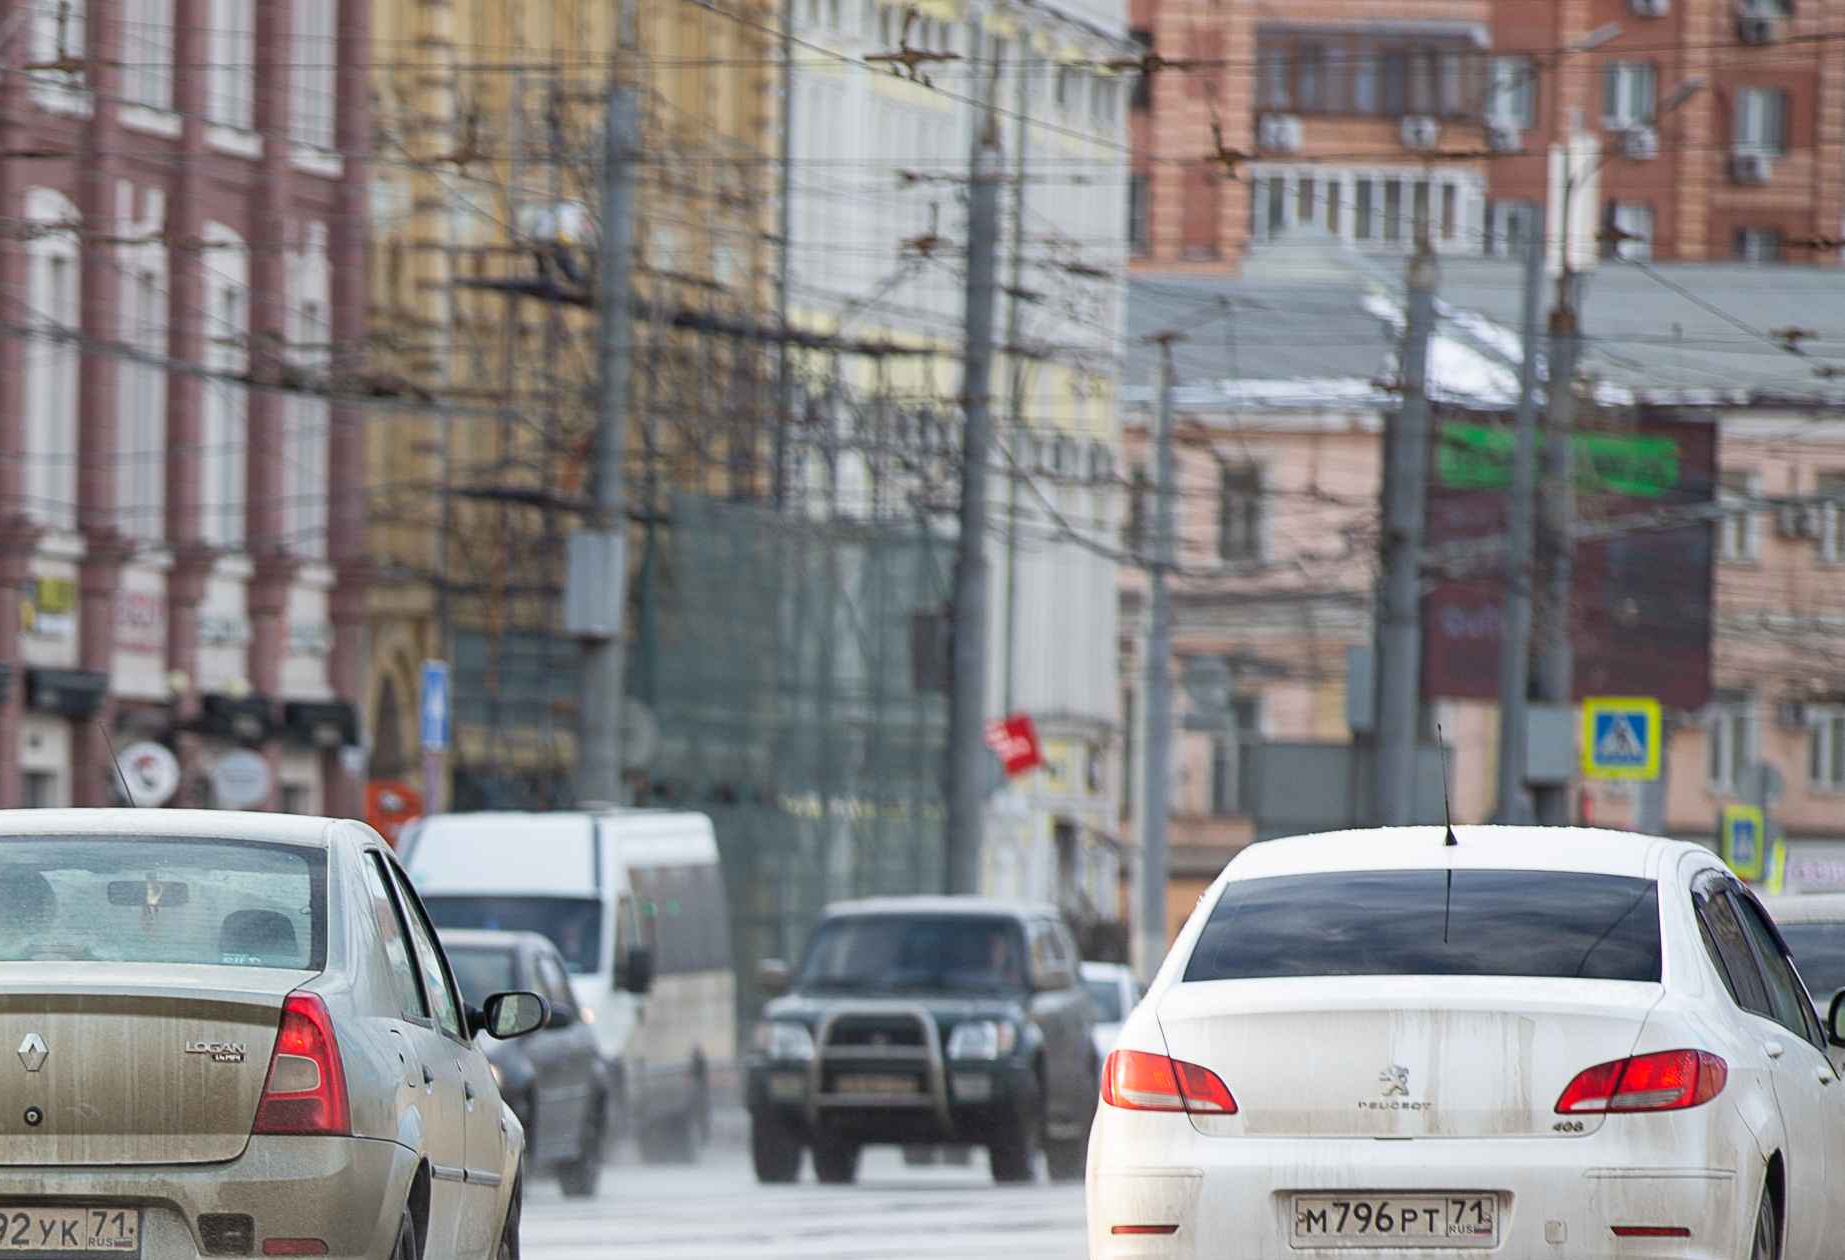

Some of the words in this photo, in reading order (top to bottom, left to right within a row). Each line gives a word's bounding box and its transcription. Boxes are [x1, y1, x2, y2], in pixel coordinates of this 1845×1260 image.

[185, 1040, 247, 1054] LOGAN
[1451, 1200, 1483, 1224] 71
[91, 1211, 125, 1237] 71
[1448, 1224, 1473, 1233] RUS
[88, 1238, 113, 1247] RUS
